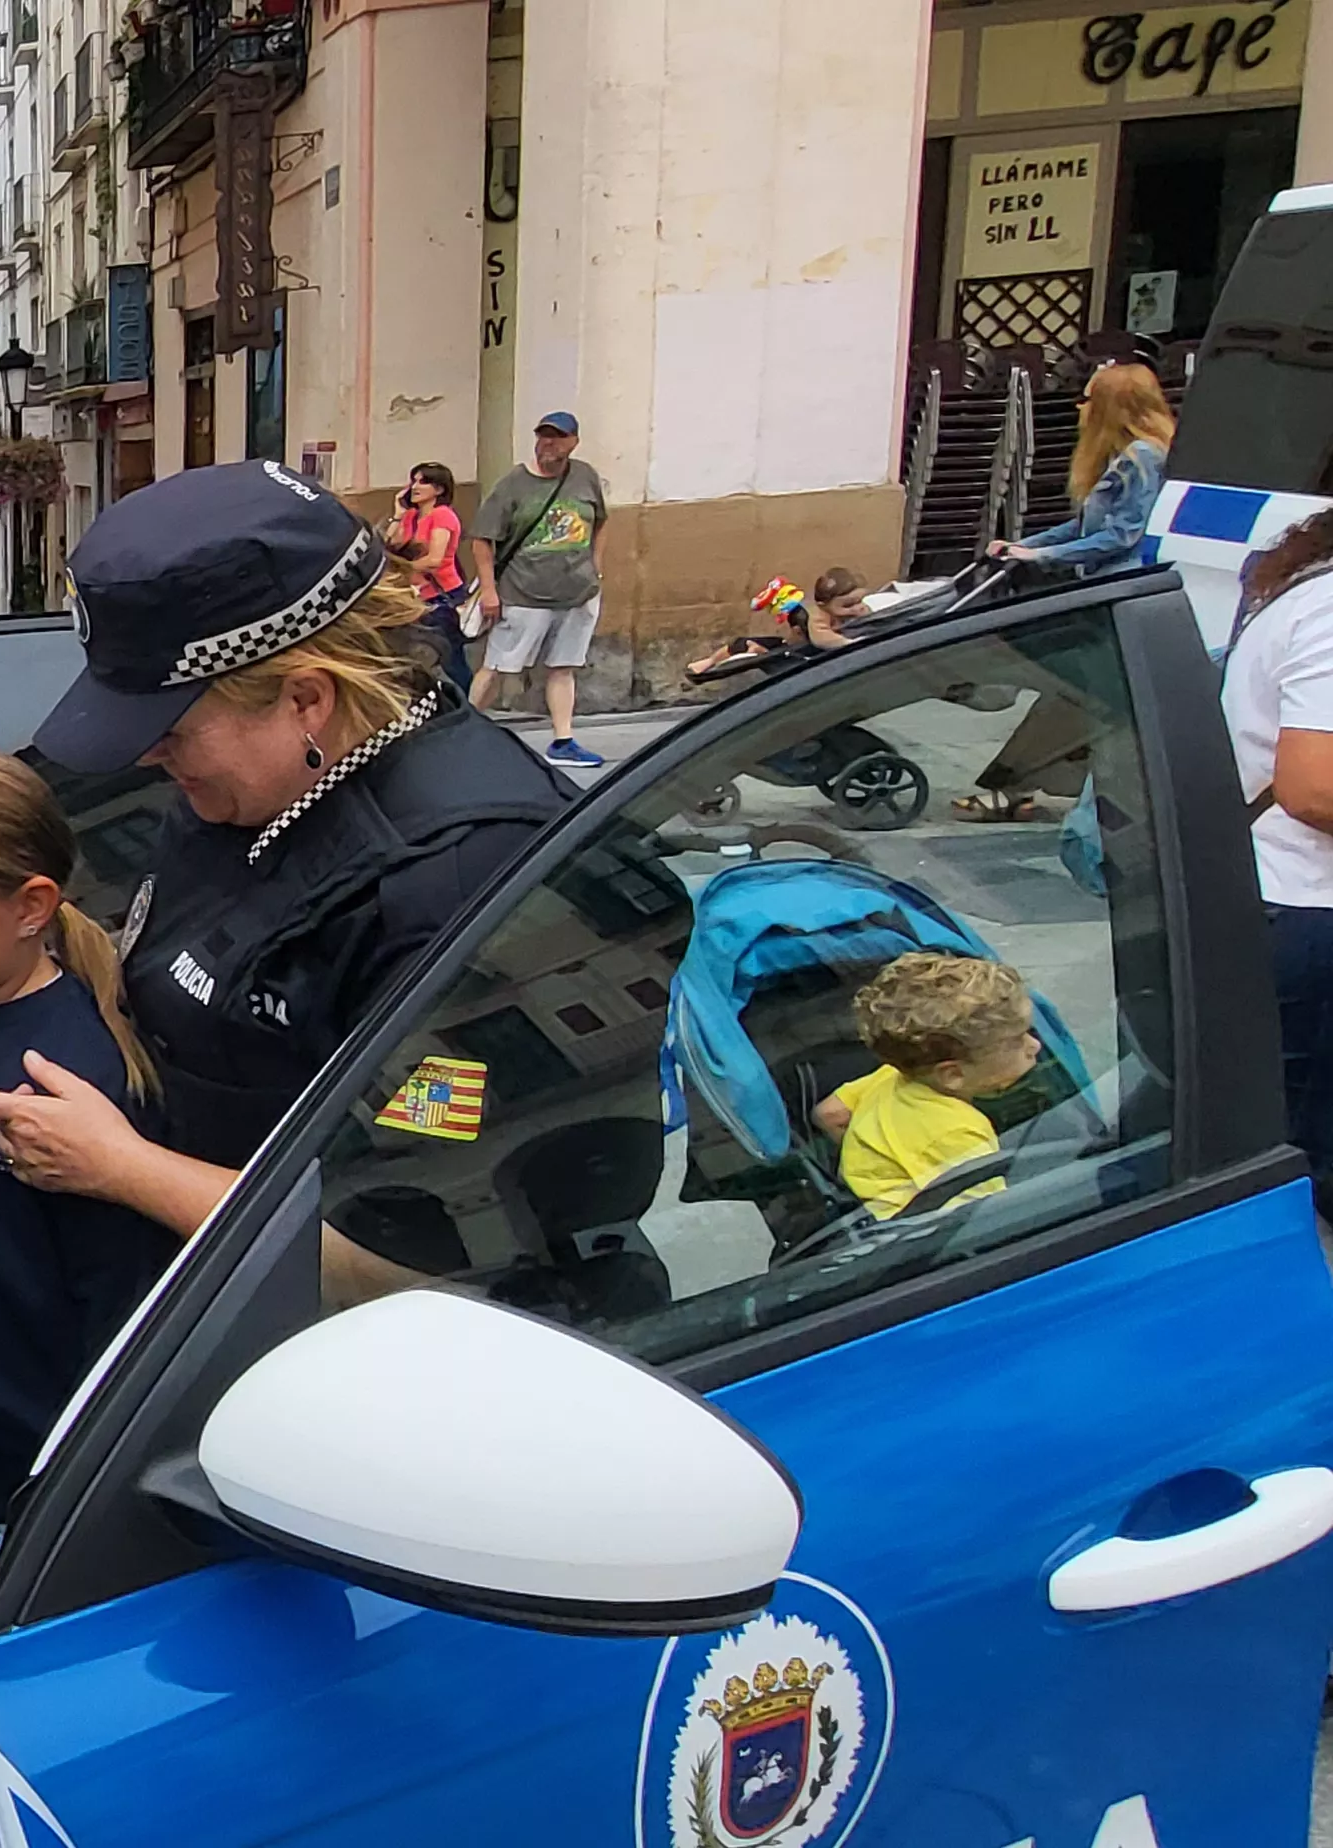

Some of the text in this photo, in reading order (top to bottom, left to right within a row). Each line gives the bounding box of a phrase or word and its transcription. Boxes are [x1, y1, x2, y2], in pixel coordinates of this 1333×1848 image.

[980, 157, 1089, 187] LLÁMAME
[989, 193, 1044, 215] PERO
[984, 216, 1061, 245] SIN LL
[168, 950, 215, 1006] POLICIA
